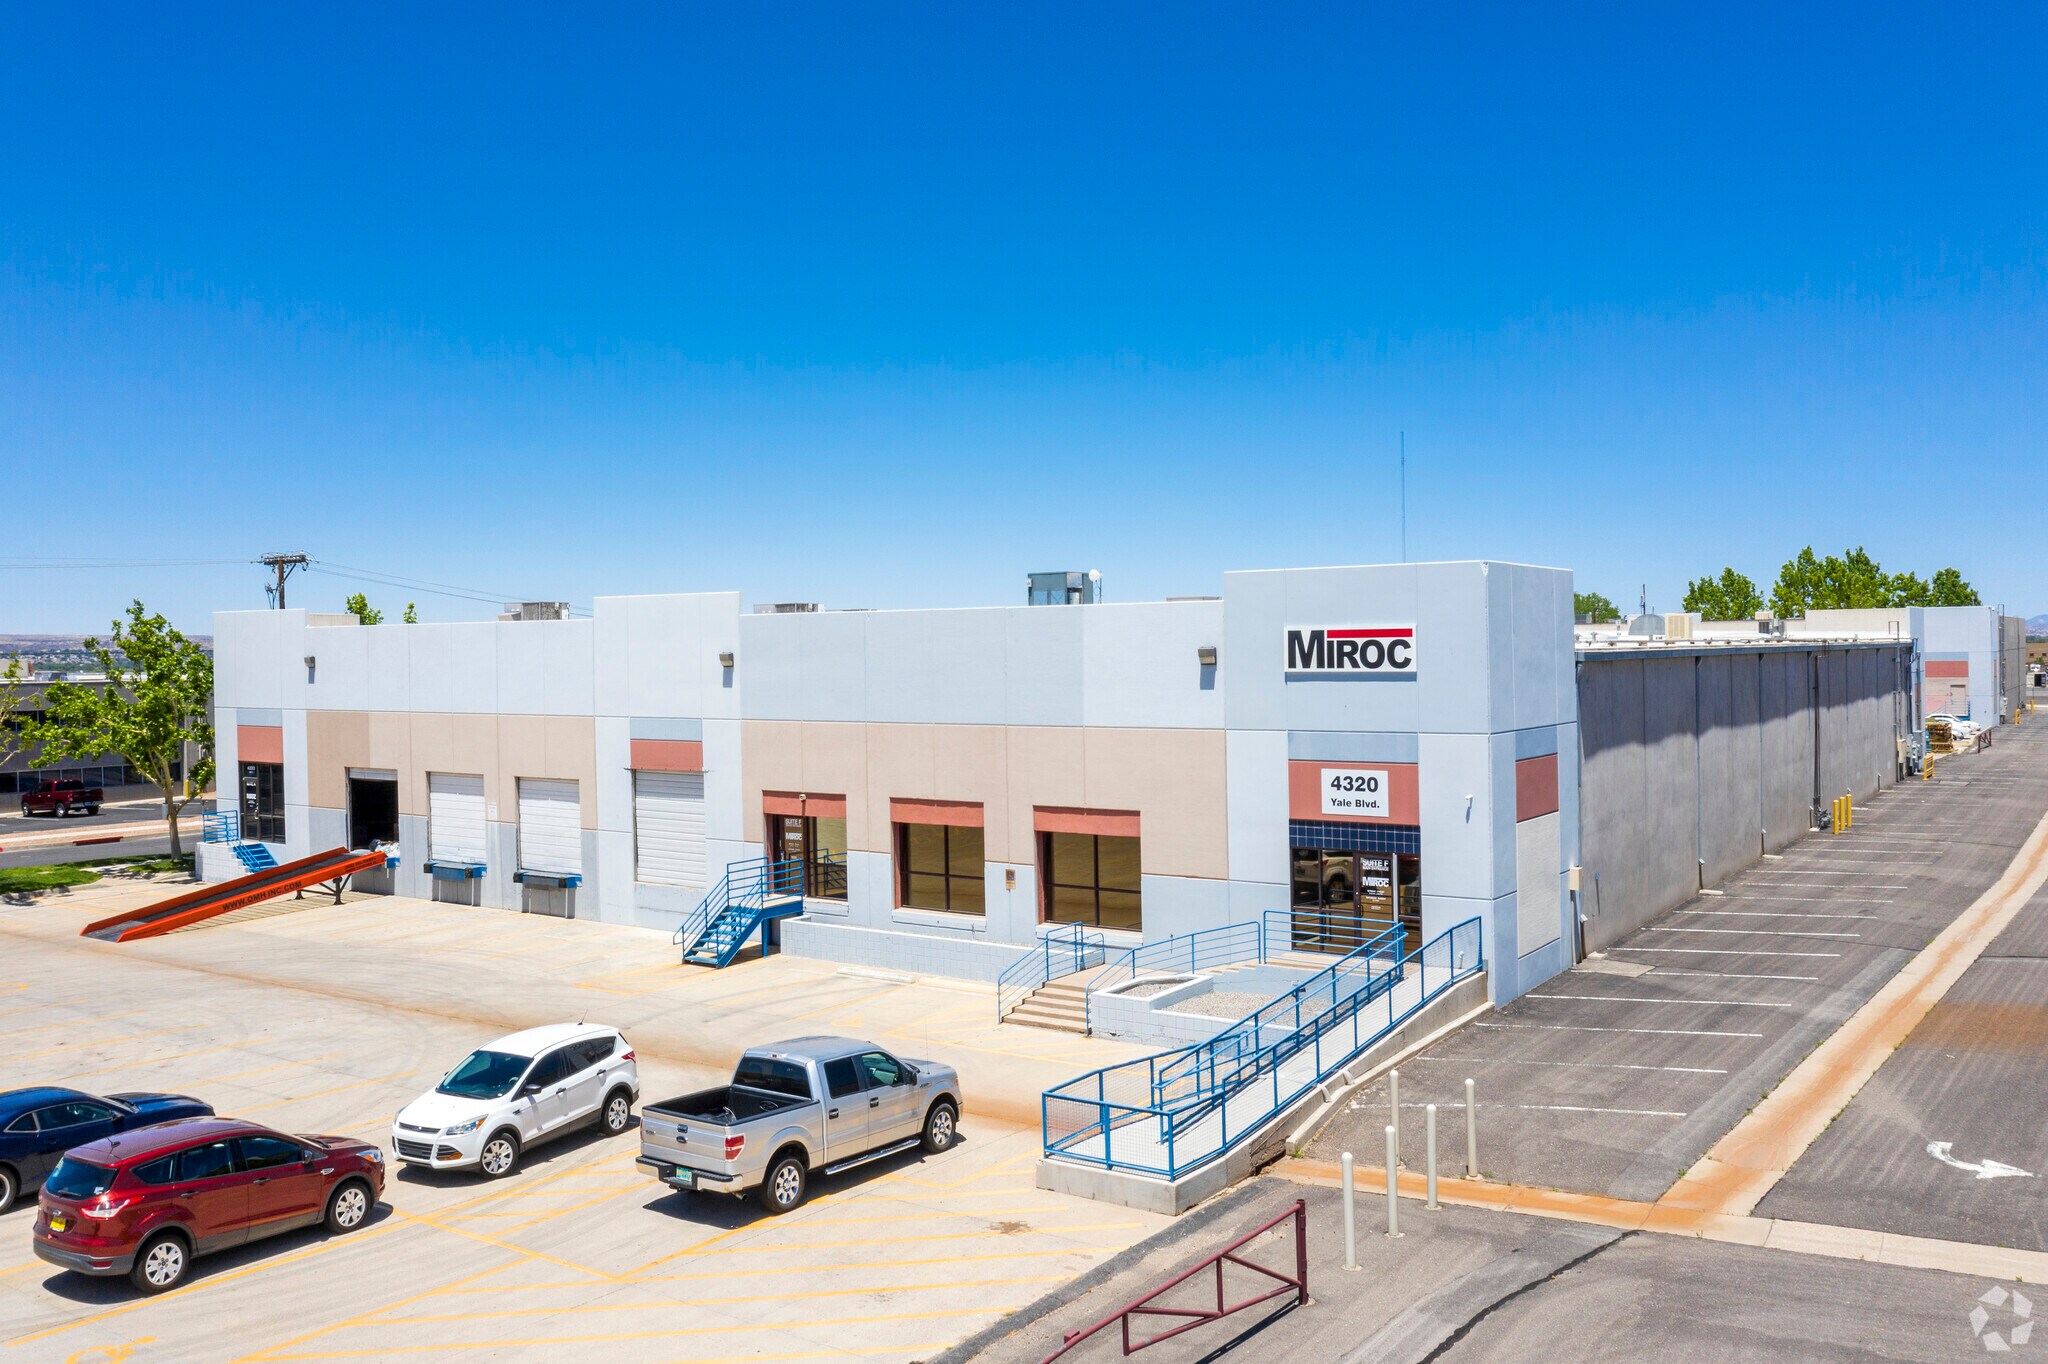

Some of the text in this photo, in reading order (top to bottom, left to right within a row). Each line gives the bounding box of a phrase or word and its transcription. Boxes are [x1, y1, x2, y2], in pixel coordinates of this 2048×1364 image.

[1330, 775, 1379, 793] 4320
[1330, 797, 1380, 809] Yale Blvd.
[1362, 858, 1389, 867] SUITE F
